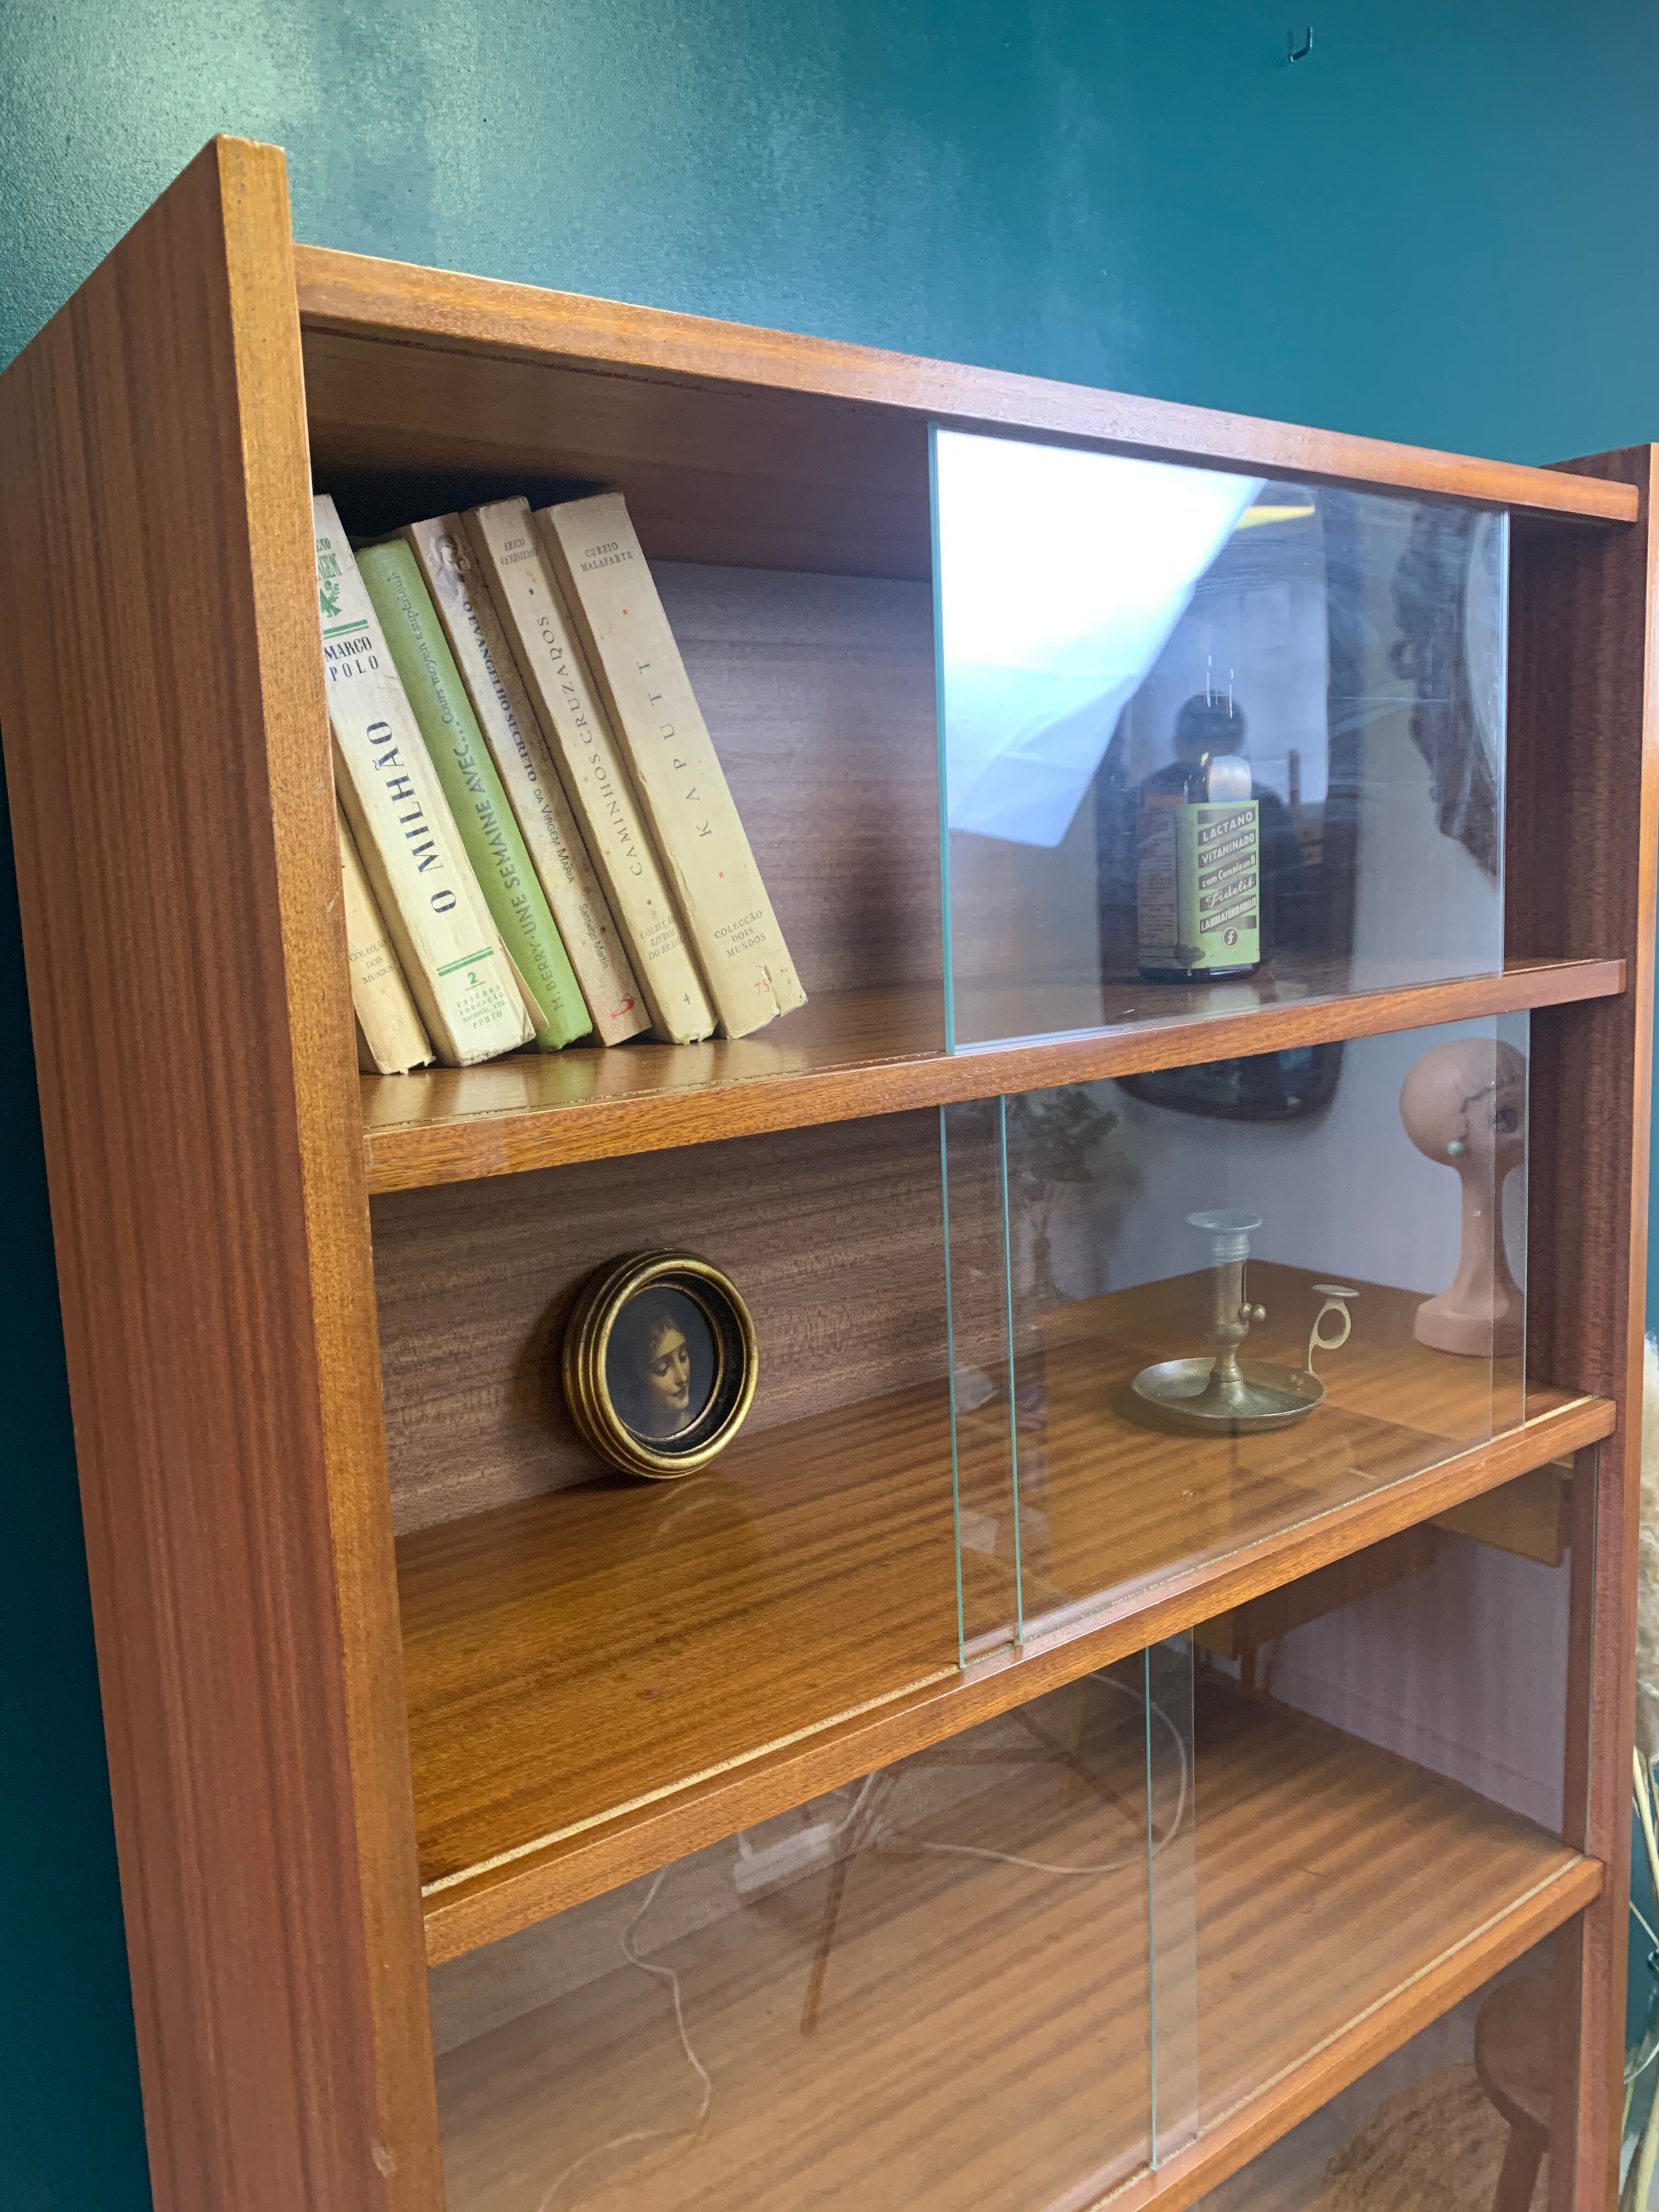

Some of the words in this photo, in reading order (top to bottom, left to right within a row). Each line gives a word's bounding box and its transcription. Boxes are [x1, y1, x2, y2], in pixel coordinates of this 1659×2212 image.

[580, 551, 633, 572] MALAPARTE
[585, 542, 618, 557] CURZIO
[324, 636, 372, 662] MARCO
[329, 655, 379, 681] POLO
[419, 642, 439, 686] moyen
[537, 616, 592, 744] CRUZADOS
[436, 689, 453, 724] Cours
[463, 600, 472, 612] O
[468, 614, 510, 711] EVANGELHO
[505, 714, 537, 782] SECRETO
[534, 788, 543, 804] DA
[636, 661, 712, 838] KAPUTT
[366, 721, 444, 875] MILHÃO
[589, 754, 642, 876] CAMINHOS
[1203, 811, 1253, 842] LACTANO
[475, 799, 521, 890] SEMAINE
[1201, 833, 1255, 864] VITAMINADO
[1202, 875, 1217, 888] com
[1217, 860, 1251, 881] Complexo
[1250, 854, 1255, 866] B
[431, 890, 456, 913] O
[1205, 876, 1254, 908] Fidelis
[1240, 897, 1256, 912] FIDELIS
[511, 894, 537, 936] UNE
[579, 903, 597, 940] Santiago
[714, 910, 763, 939] COLECÇÃO
[651, 928, 675, 947] LIVROS
[726, 933, 766, 957] MUNDOS
[731, 927, 754, 943] DOIS
[366, 957, 383, 969] DOIS
[648, 949, 660, 961] DO
[363, 965, 393, 984] MUNDOS
[467, 972, 478, 984] 2
[684, 992, 690, 1005] 4
